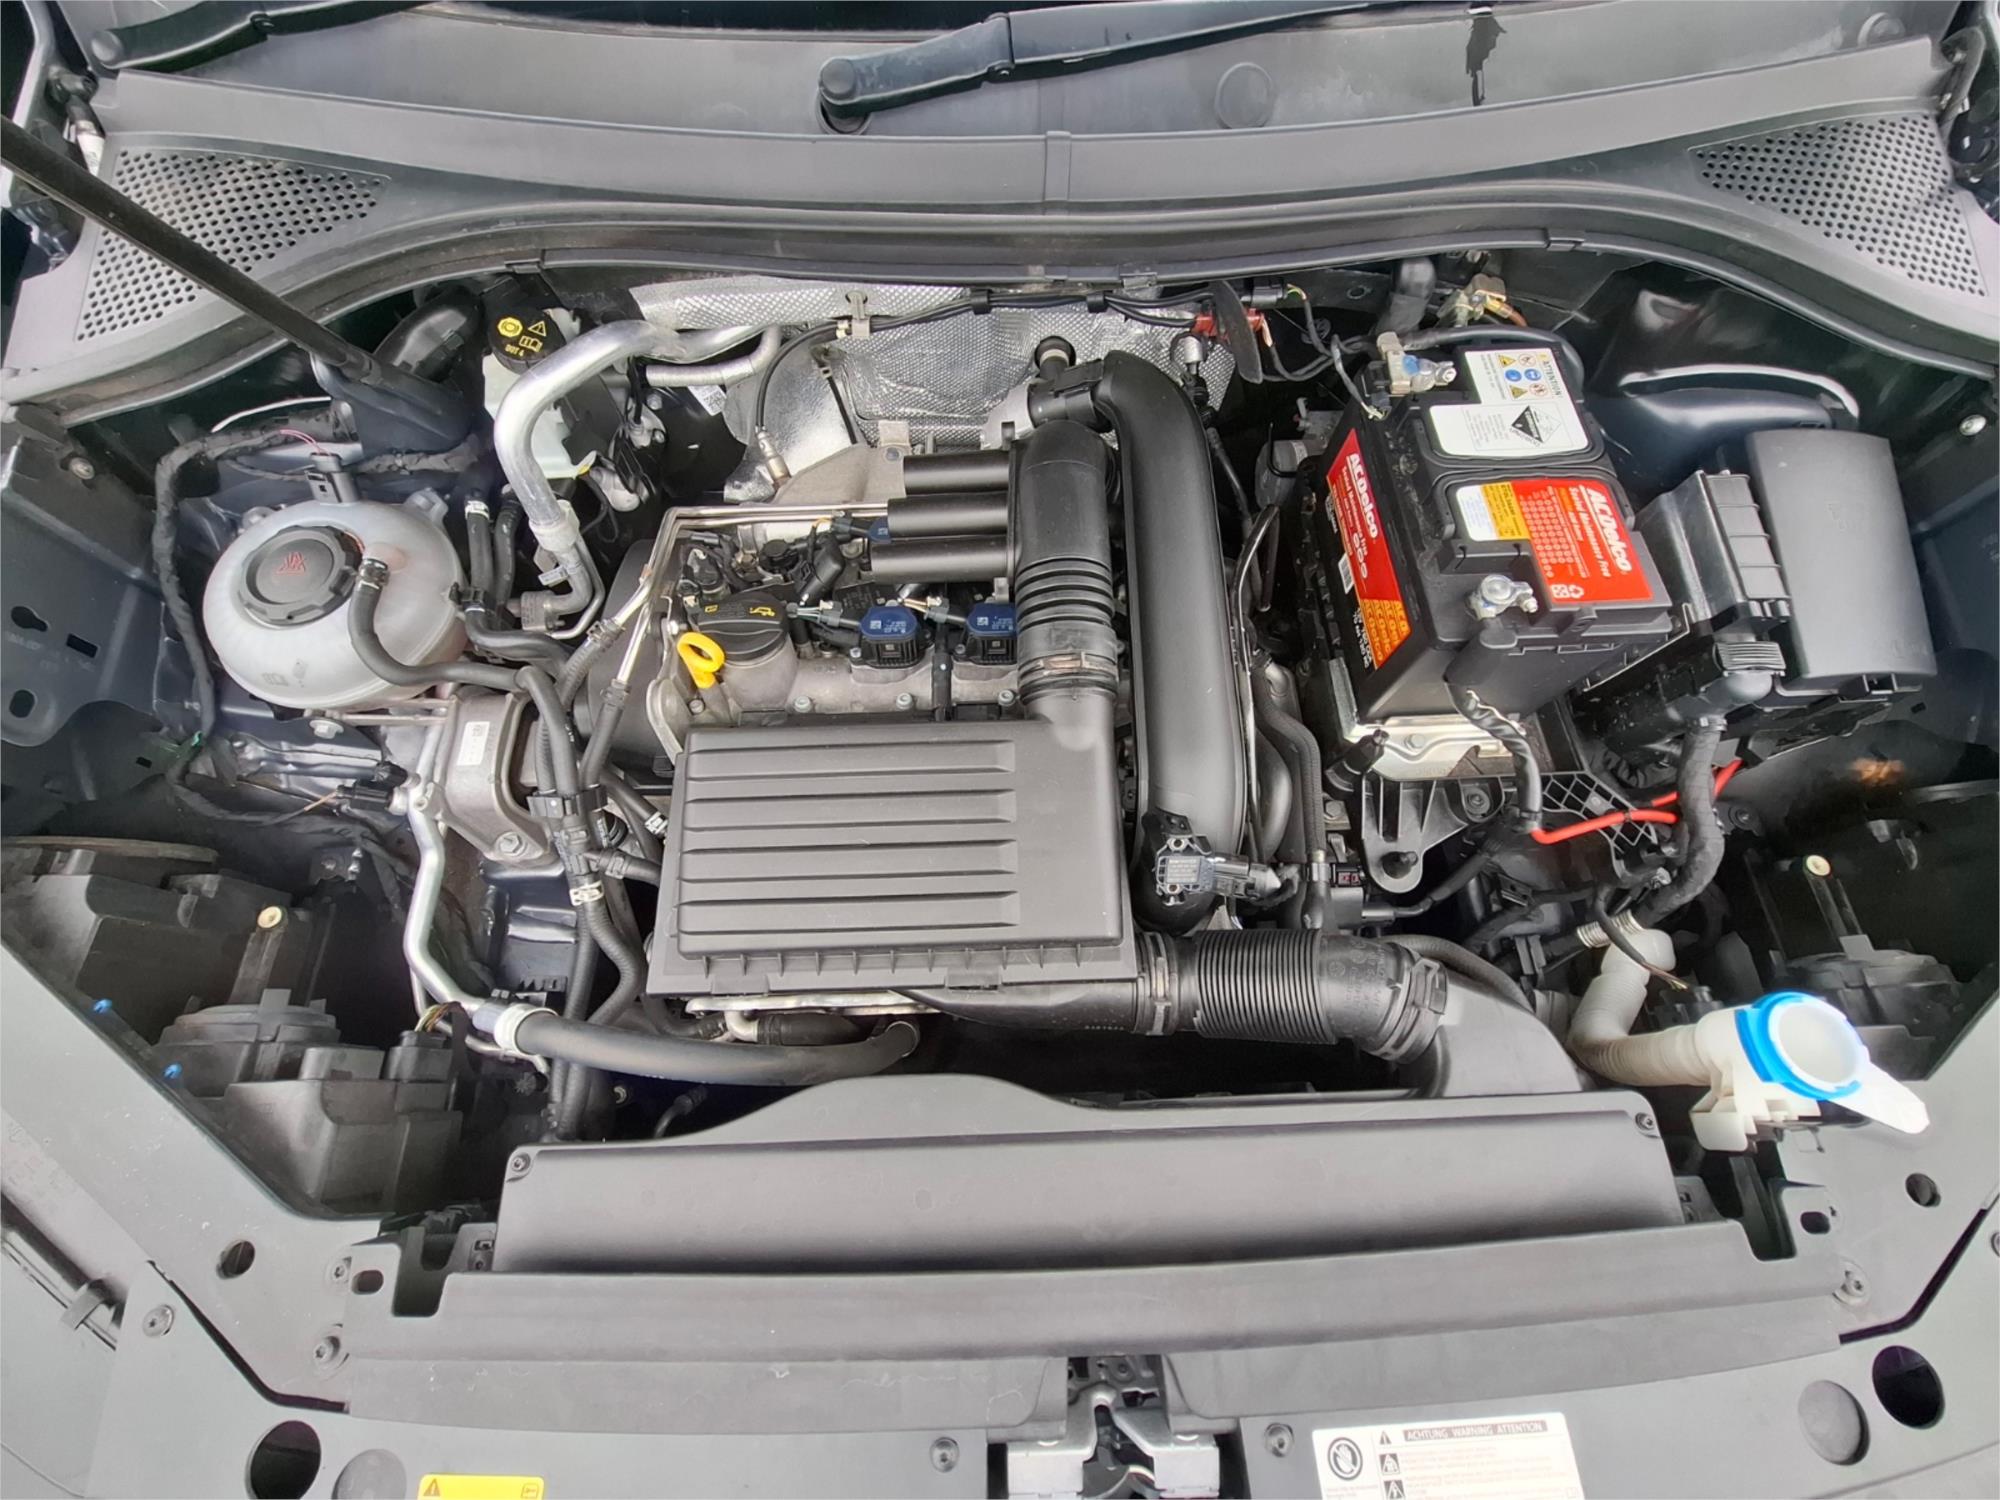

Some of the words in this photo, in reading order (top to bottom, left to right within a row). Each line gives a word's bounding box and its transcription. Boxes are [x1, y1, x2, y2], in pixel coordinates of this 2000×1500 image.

[505, 345, 519, 355] DOT
[1341, 466, 1352, 491] Sealed
[1349, 453, 1380, 539] ACDelco
[1568, 486, 1585, 512] Sealed
[1578, 512, 1604, 560] Maintenance
[1598, 560, 1611, 579] Free
[1586, 488, 1633, 575] ACDelco
[1408, 1428, 1449, 1441] ACHTUNG
[1452, 1424, 1494, 1438] WARNING
[1497, 1421, 1544, 1435] ATTENTION
